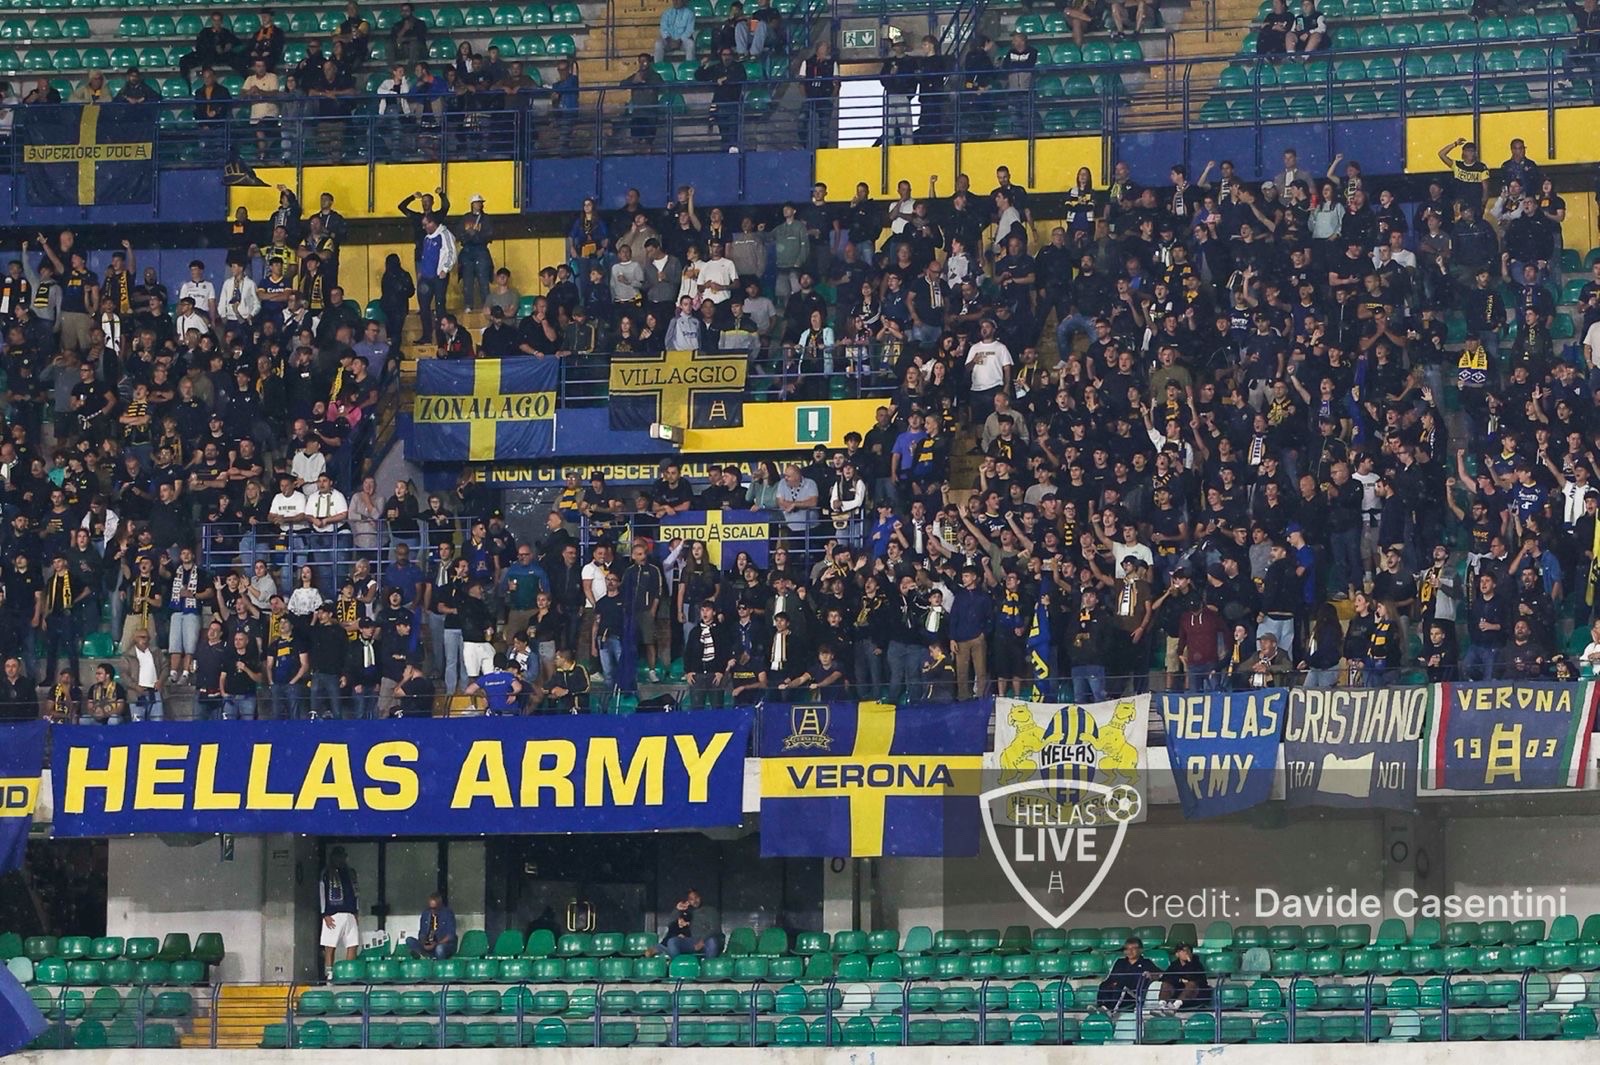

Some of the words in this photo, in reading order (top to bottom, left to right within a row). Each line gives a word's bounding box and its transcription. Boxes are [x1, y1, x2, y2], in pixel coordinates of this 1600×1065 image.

[28, 145, 102, 160] SUPERIORE
[106, 145, 133, 159] DOC
[618, 363, 738, 388] VILLAGGIO
[491, 465, 533, 482] NON
[537, 464, 556, 482] CI
[561, 463, 667, 482] CONOSCET
[680, 461, 752, 478] ALLA
[663, 527, 706, 540] SOTTO
[722, 525, 765, 540] SCALA
[1457, 686, 1572, 713] VERONA
[1161, 692, 1282, 740] HELLAS
[1285, 687, 1429, 745] CRISTIANO
[1040, 743, 1096, 766] HELLAS
[63, 740, 421, 815] HELLAS
[450, 730, 735, 810] ARMY
[786, 764, 956, 790] VERONA
[1287, 760, 1317, 790] TRA
[1376, 760, 1406, 790] NOI
